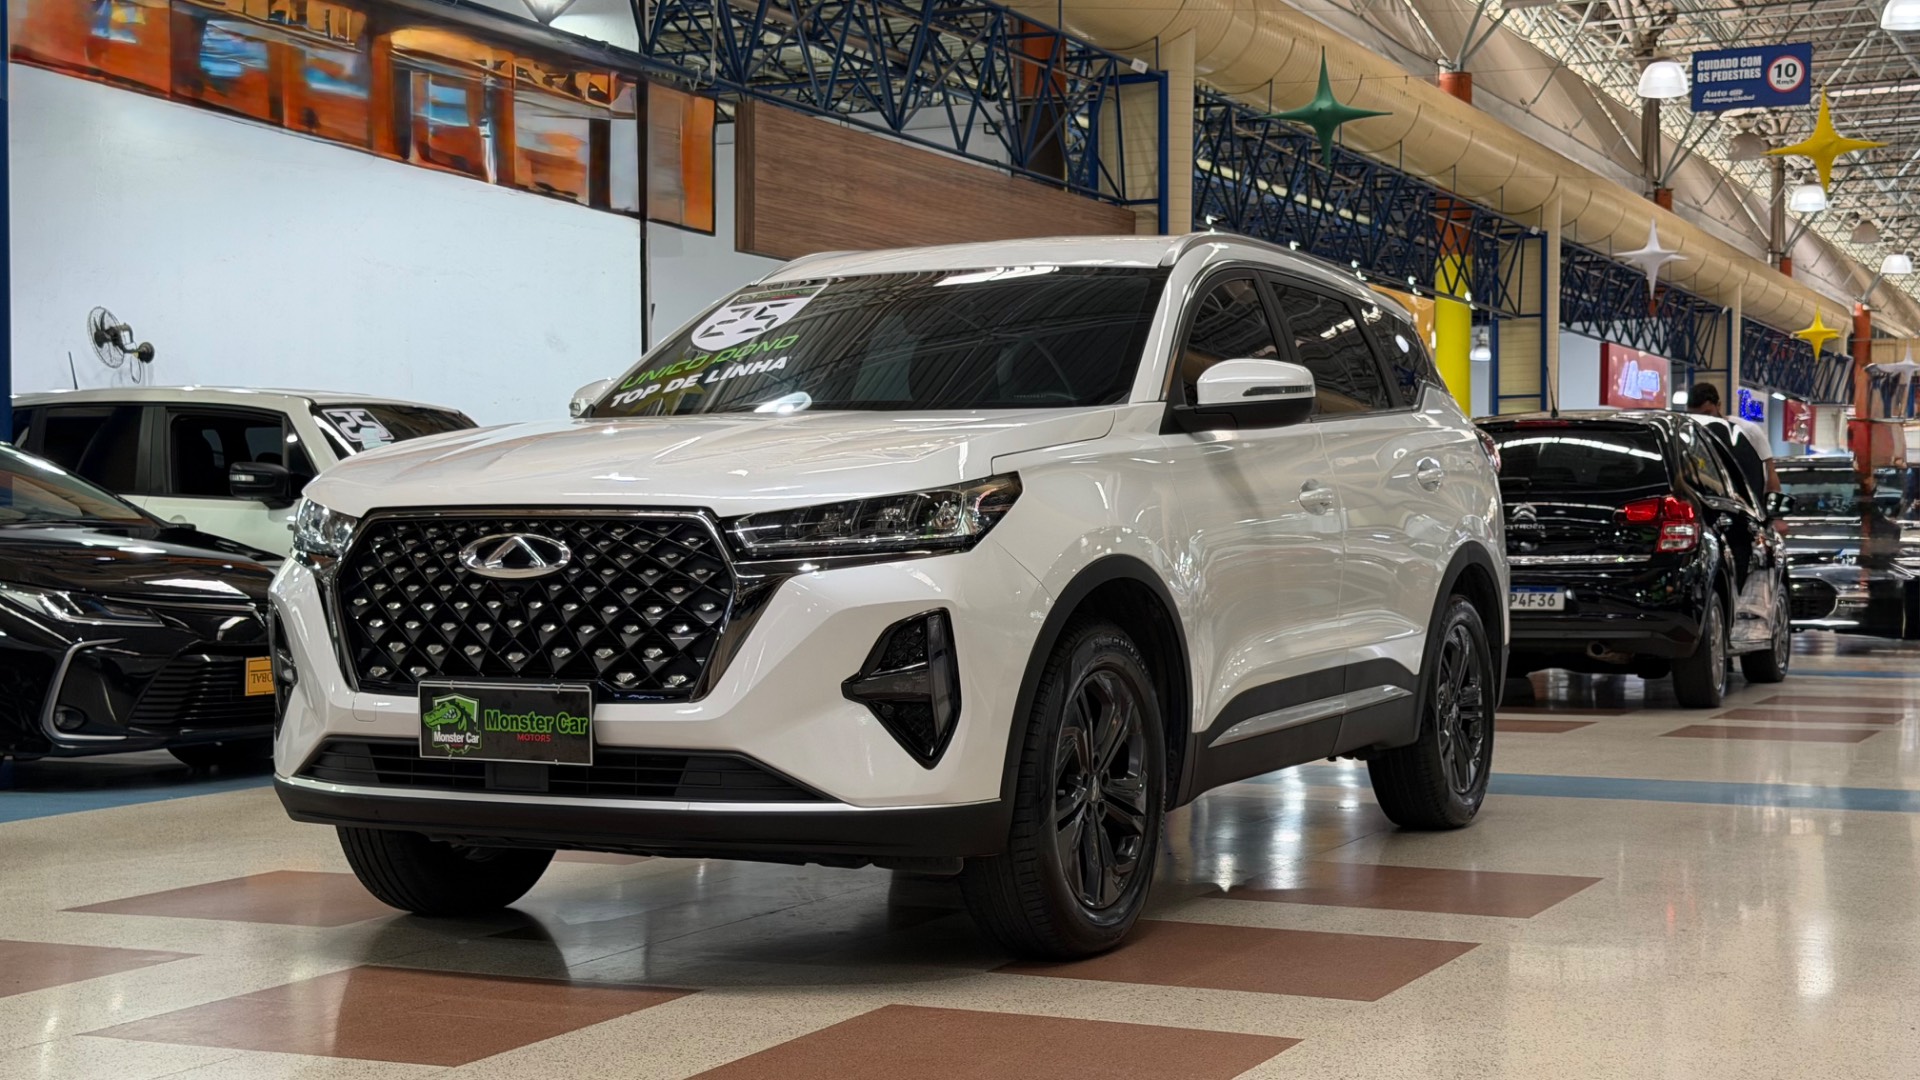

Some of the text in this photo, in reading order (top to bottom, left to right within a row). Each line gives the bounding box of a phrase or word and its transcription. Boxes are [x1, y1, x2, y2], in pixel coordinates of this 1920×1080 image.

[1697, 56, 1762, 70] CUIDADO COM
[1697, 68, 1761, 83] OS PEDESTRES
[1773, 63, 1797, 78] 10
[1703, 90, 1728, 98] Auto
[699, 302, 795, 338] 25
[620, 334, 800, 390] UNICO DONO
[609, 355, 791, 408] TOP DE LINHA
[1510, 593, 1556, 607] P4F36
[251, 672, 272, 683] OBAL
[484, 709, 589, 735] Monster Car
[433, 731, 480, 744] Monster Car
[517, 733, 551, 743] MOTORS
